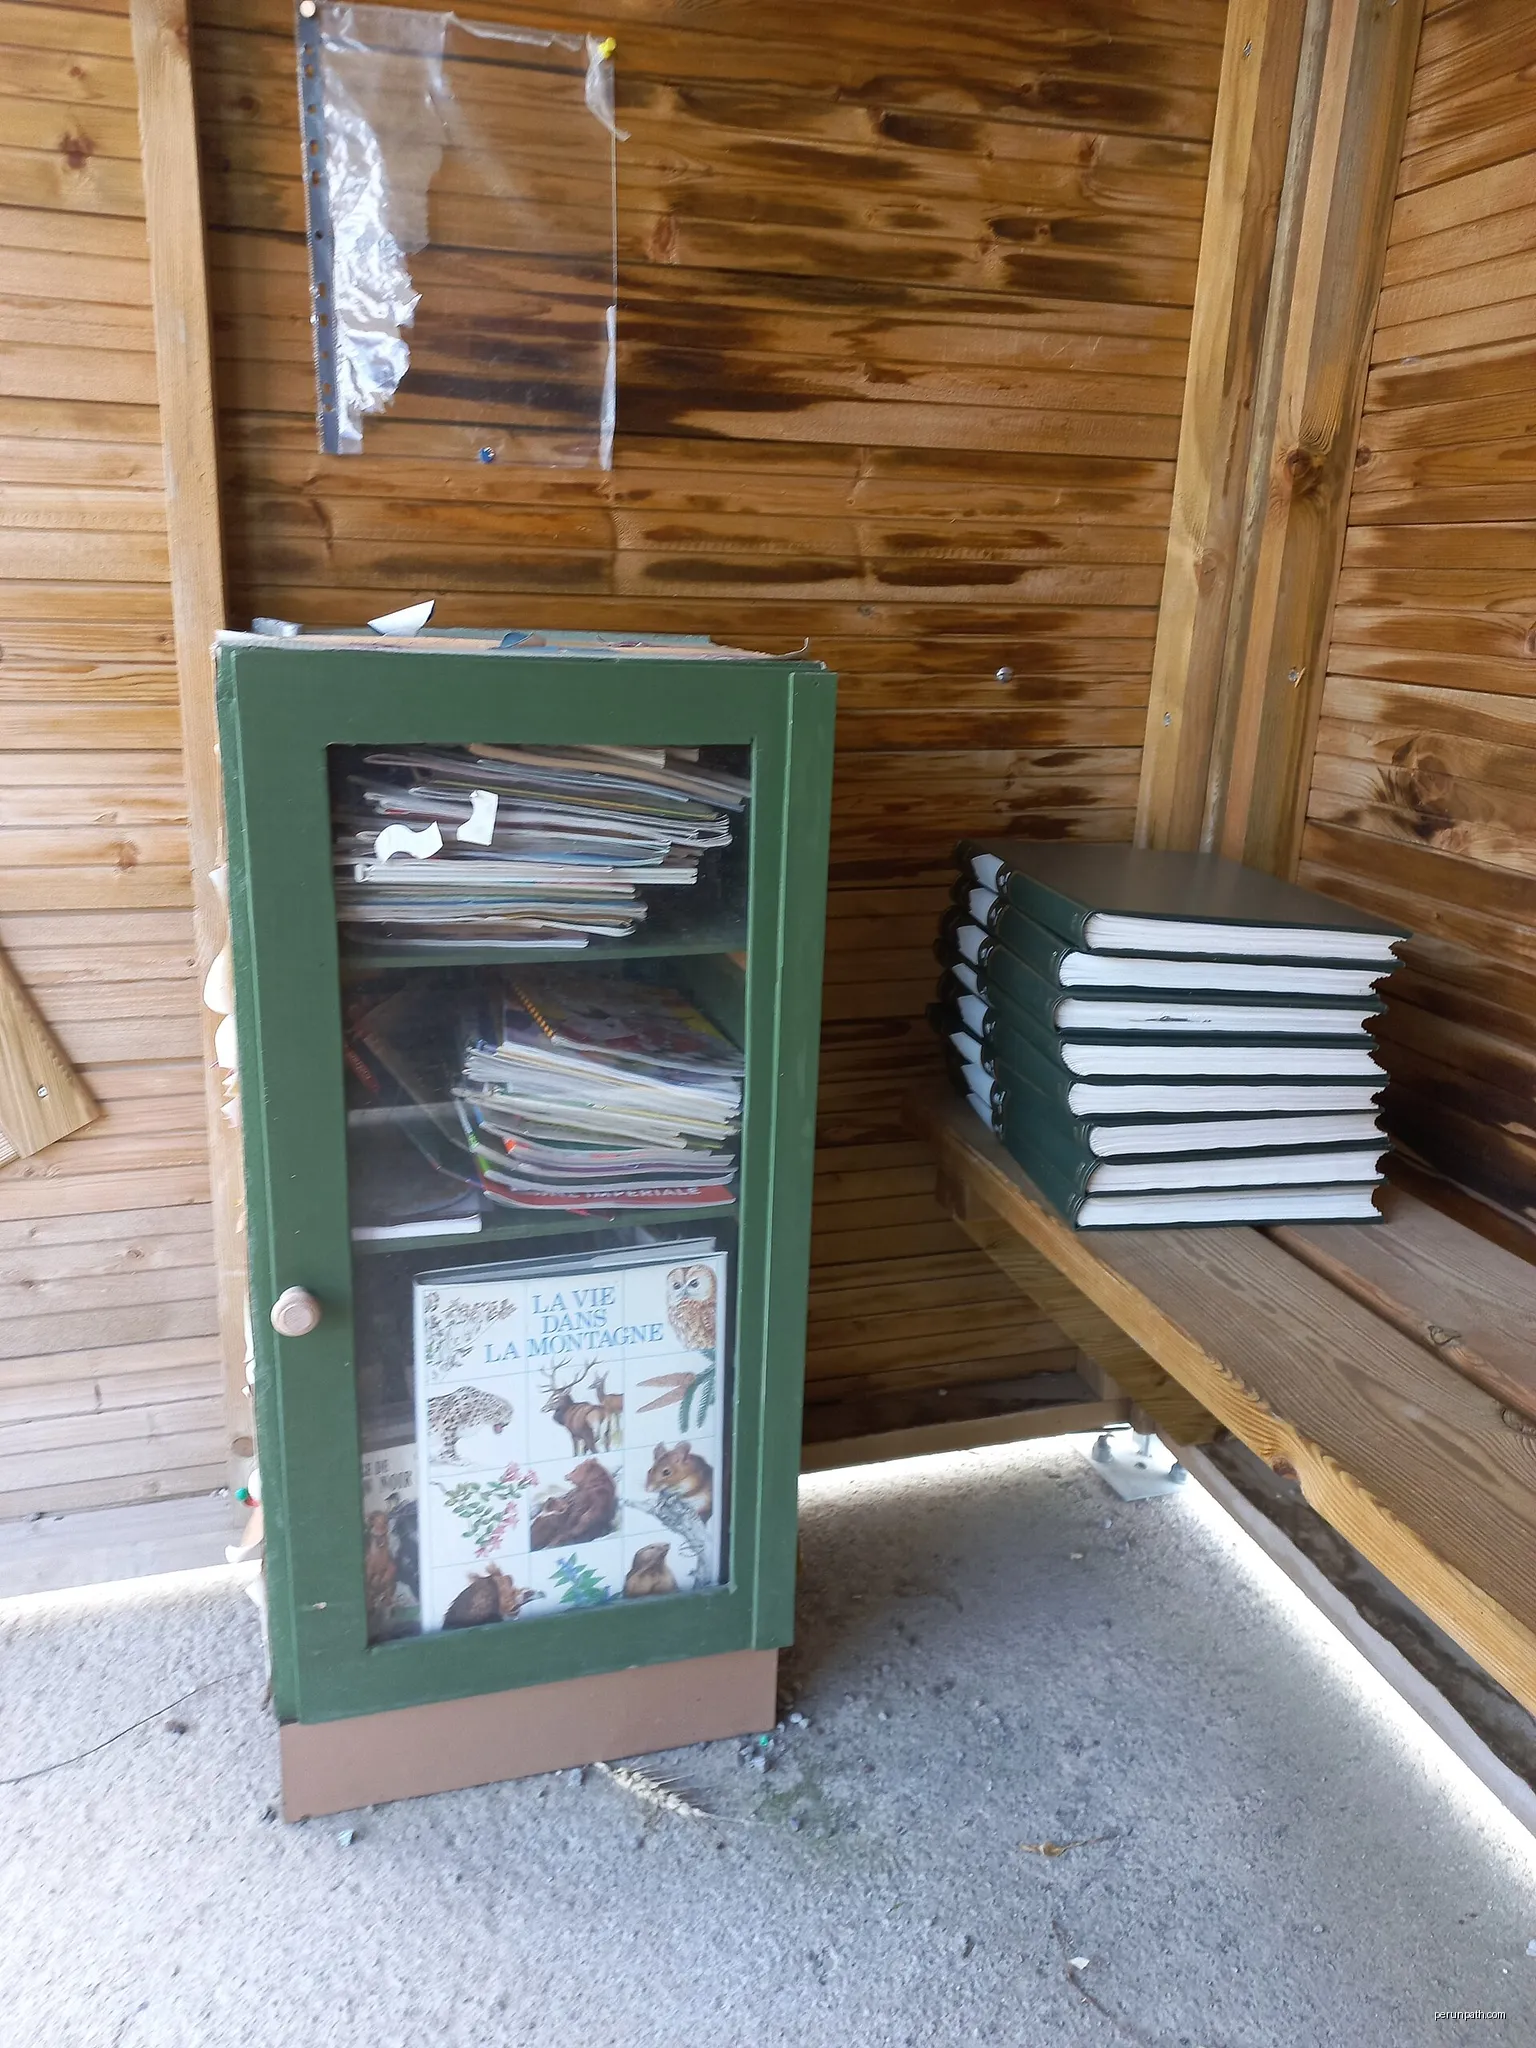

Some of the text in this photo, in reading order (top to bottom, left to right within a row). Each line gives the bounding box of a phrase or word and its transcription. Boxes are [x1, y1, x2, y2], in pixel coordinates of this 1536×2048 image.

[532, 1286, 617, 1314] LA VIE
[541, 1309, 608, 1335] DANS
[484, 1322, 666, 1363] LA MONTAGNE
